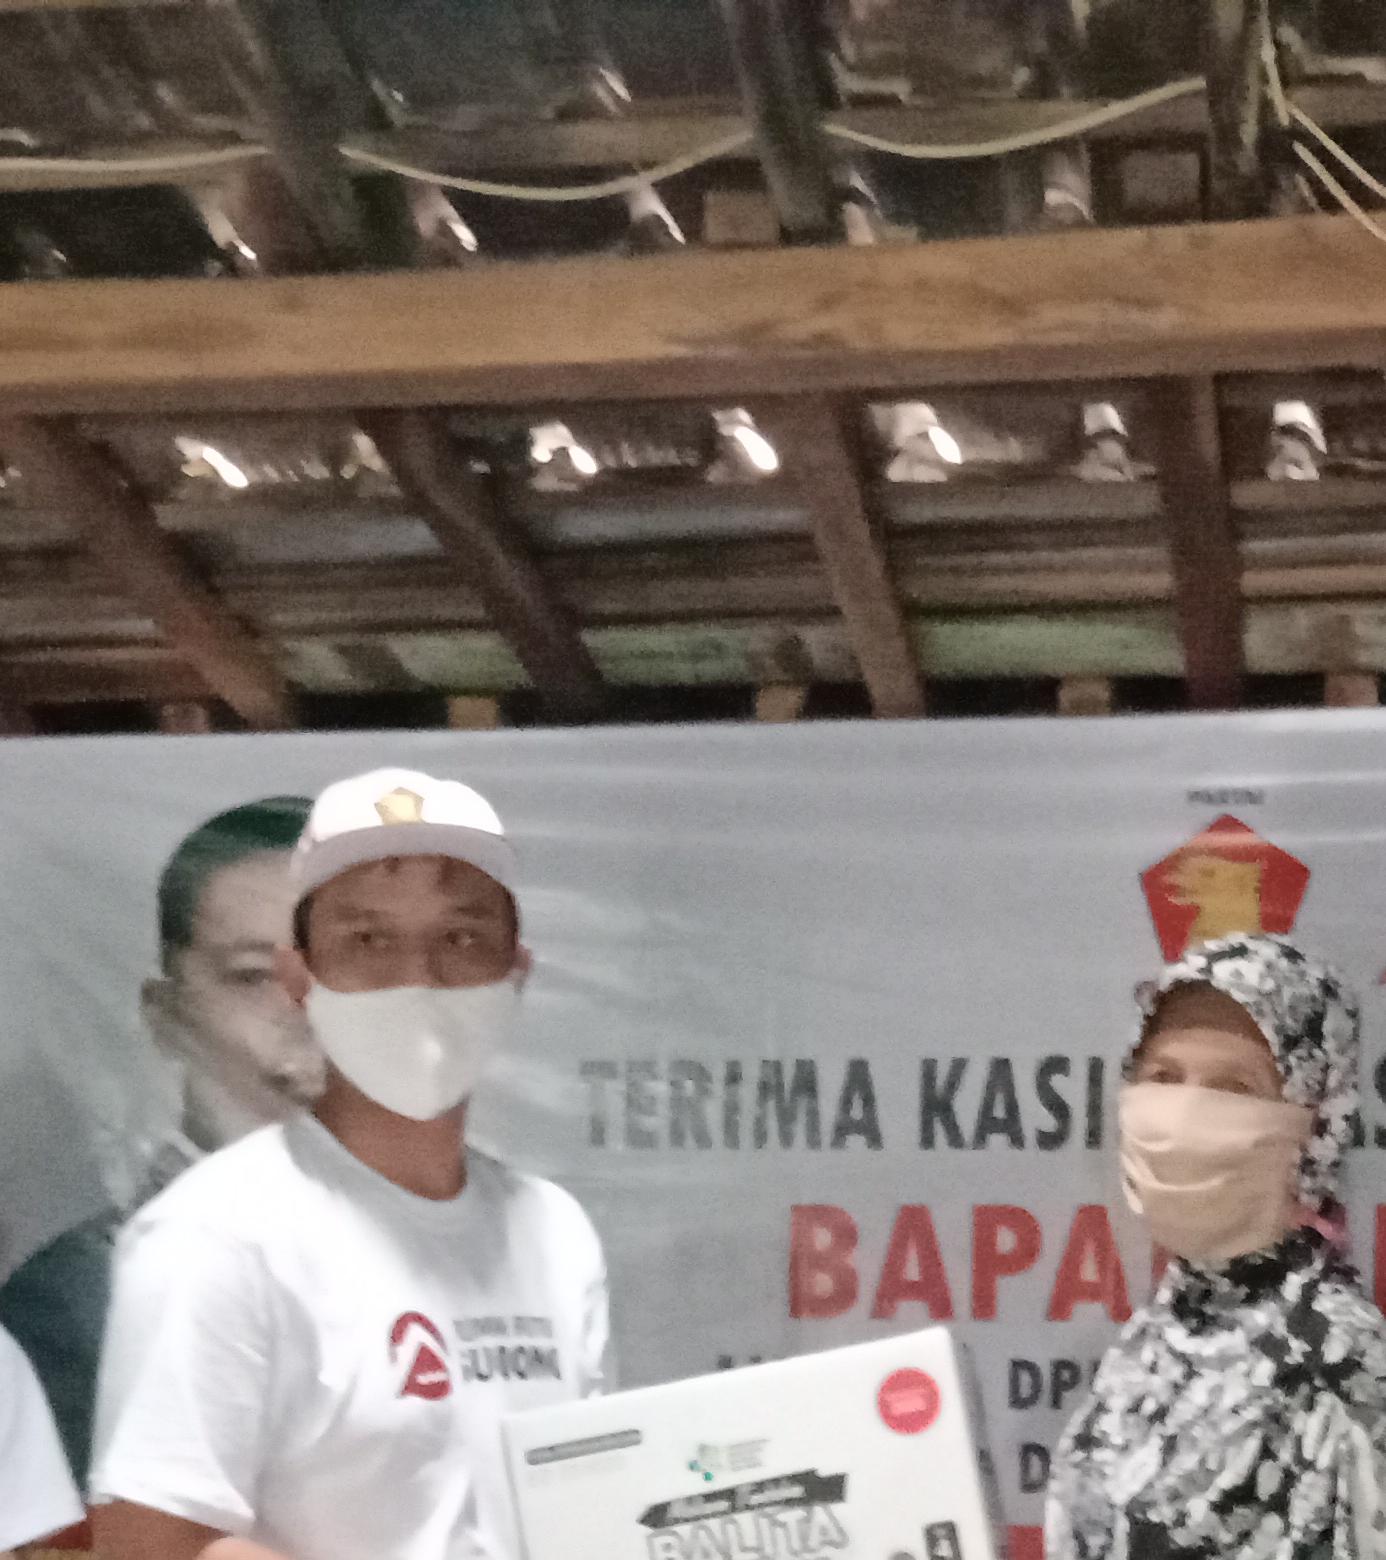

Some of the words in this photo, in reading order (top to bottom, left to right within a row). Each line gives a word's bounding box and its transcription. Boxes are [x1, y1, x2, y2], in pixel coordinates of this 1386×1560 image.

[579, 1056, 884, 1151] TERIMA
[917, 1055, 1106, 1151] KASI
[787, 1204, 1165, 1323] BAPA
